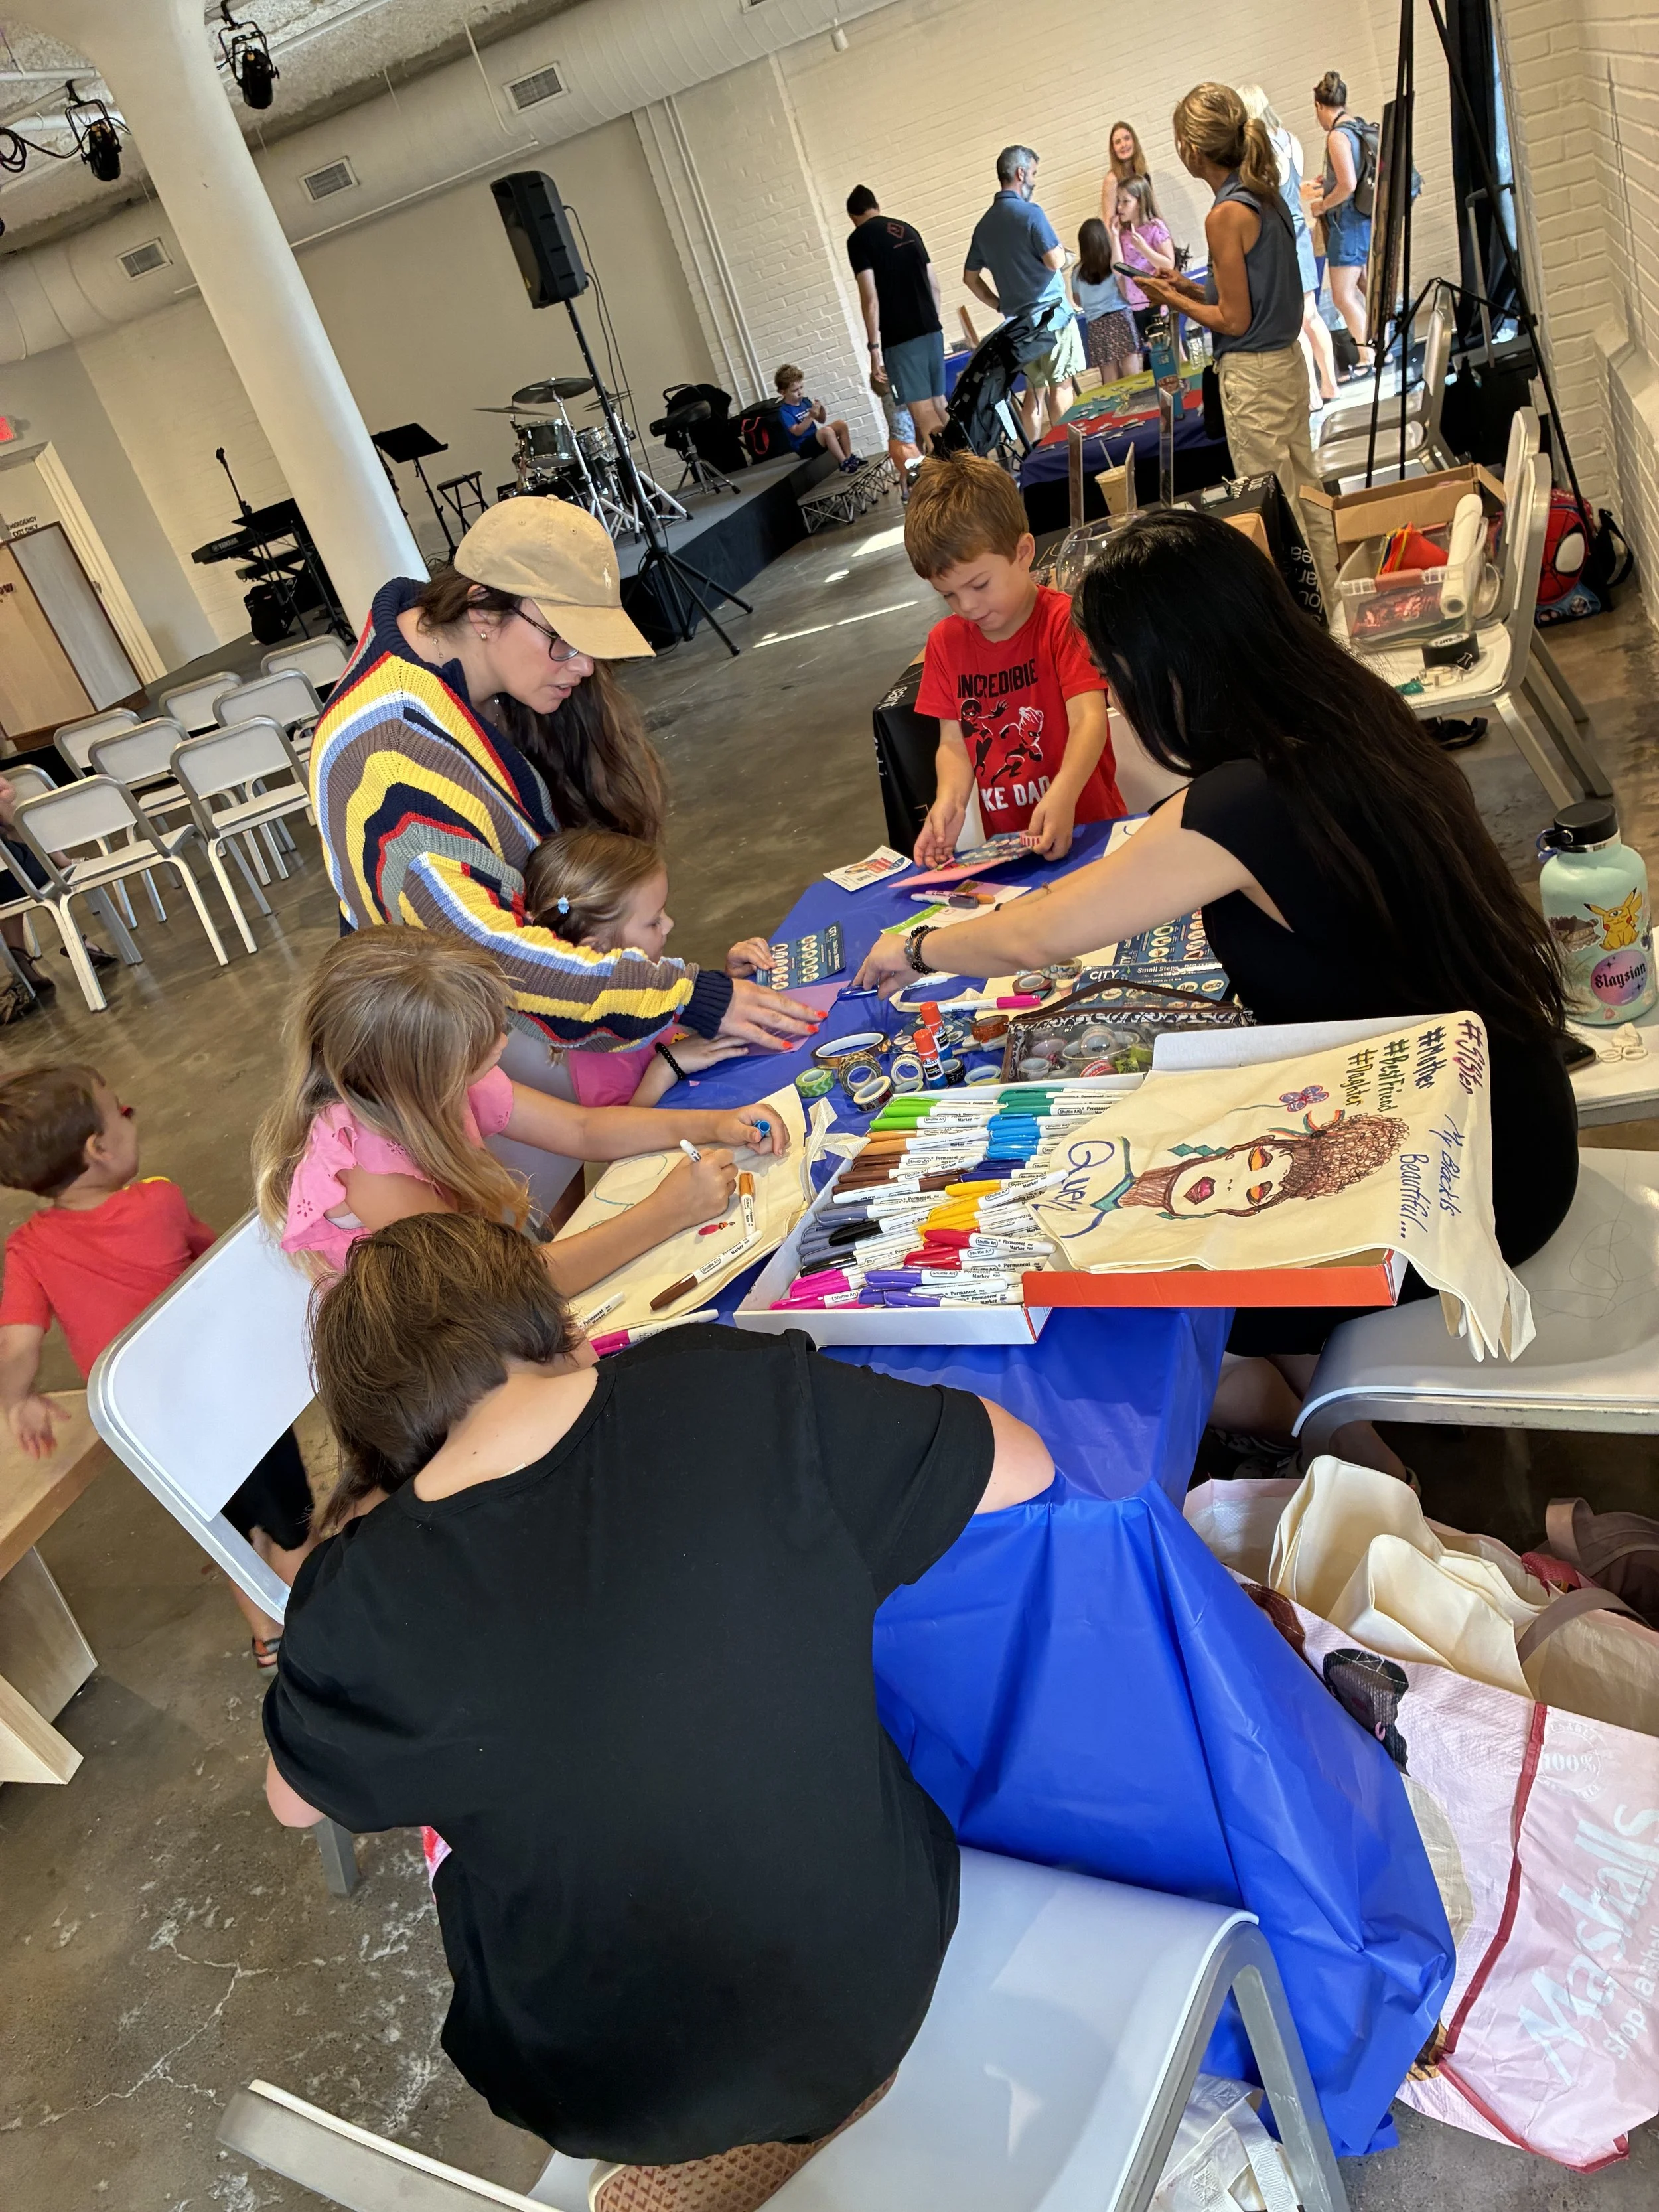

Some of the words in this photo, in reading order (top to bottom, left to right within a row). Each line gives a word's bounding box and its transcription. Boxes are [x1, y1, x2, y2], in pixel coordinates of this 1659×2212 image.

[958, 659, 1038, 698] INCREDIBLE
[981, 787, 1009, 812] KE
[1089, 969, 1120, 980] CITY
[1595, 963, 1646, 988] Slaysian
[1413, 1026, 1447, 1089] #Mother
[1429, 1114, 1465, 1149] My
[1439, 1150, 1461, 1199] Black
[1542, 1752, 1597, 1773] 100%
